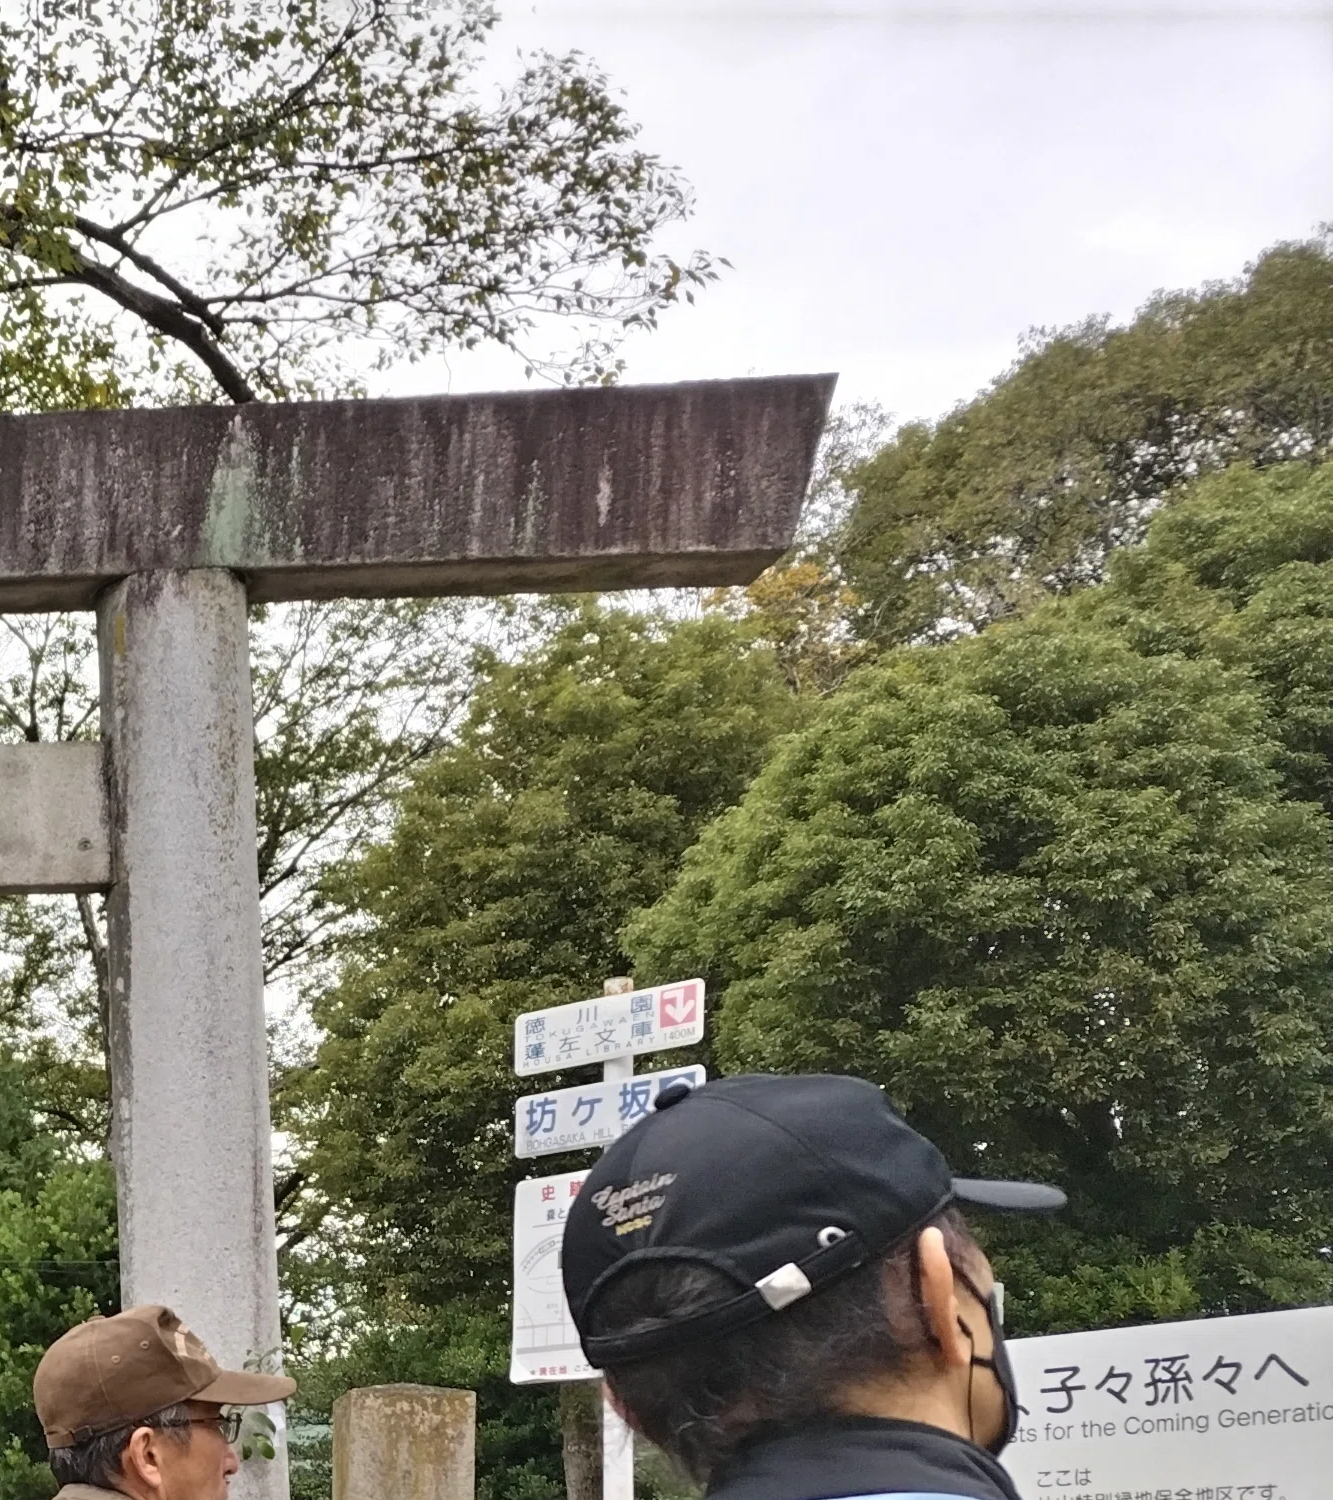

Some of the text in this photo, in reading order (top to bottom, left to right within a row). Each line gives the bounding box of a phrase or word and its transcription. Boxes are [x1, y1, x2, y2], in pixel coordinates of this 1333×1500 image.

[524, 993, 653, 1036] 徳川園
[524, 1020, 653, 1061] 蓬左文庫
[663, 1026, 696, 1043] 1400M
[522, 1036, 656, 1068] HOUSA LIBRARY
[526, 1132, 586, 1152] BOHGASAKA
[593, 1127, 615, 1140] HILL
[1044, 1422, 1075, 1441] for
[1082, 1419, 1116, 1438] the
[1124, 1413, 1210, 1435] Coming
[1036, 1468, 1092, 1488] ここは
